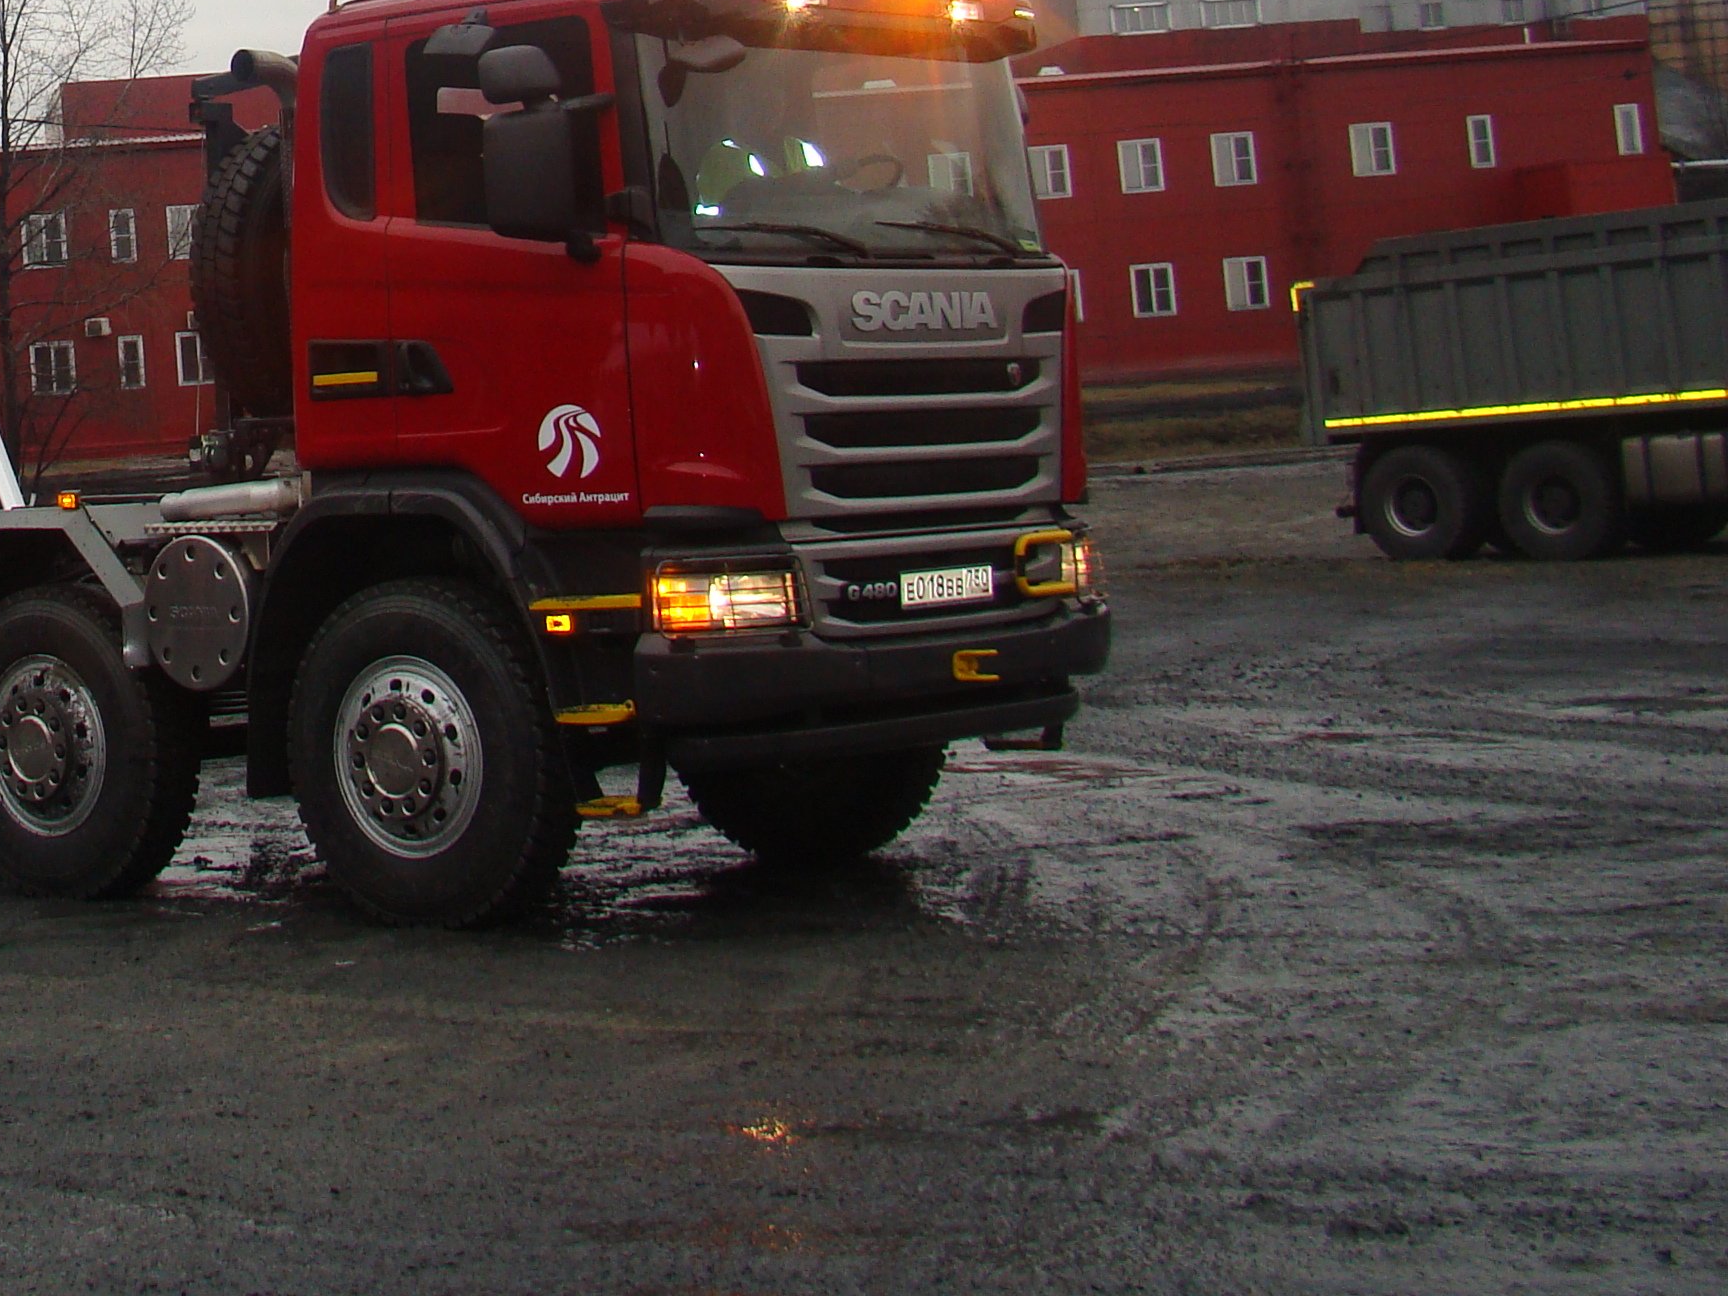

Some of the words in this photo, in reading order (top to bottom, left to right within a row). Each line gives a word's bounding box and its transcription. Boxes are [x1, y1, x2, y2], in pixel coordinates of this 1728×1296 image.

[851, 290, 998, 331] SCANIA
[522, 492, 577, 506] Сибирский
[578, 491, 630, 504] Антрацит
